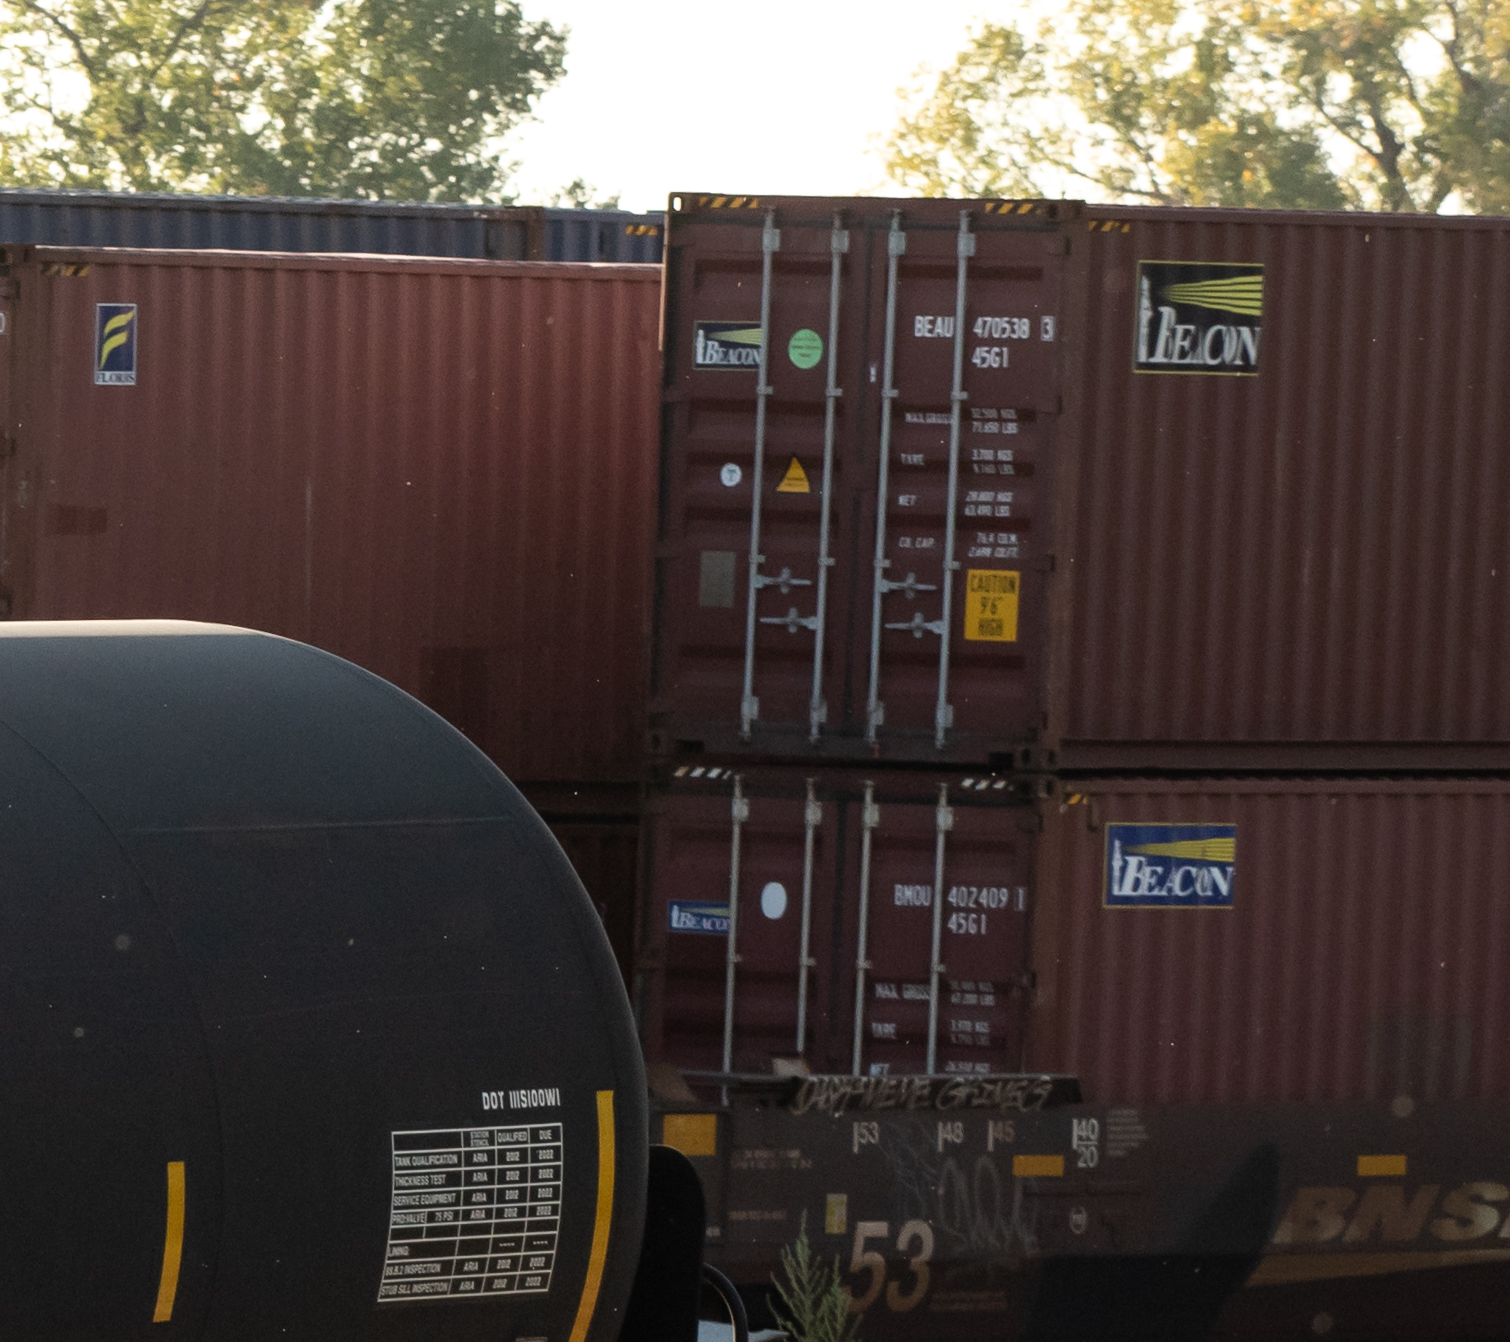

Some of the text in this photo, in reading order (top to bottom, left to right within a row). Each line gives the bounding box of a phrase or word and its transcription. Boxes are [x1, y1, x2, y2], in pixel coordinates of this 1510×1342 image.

[914, 316, 1054, 339] BEAU 470538 3
[971, 346, 1009, 368] 45G1
[1122, 855, 1233, 897] BEACON
[947, 886, 1007, 908] 402409
[946, 913, 988, 935] 45G1
[482, 1092, 504, 1110] DOT
[431, 1174, 446, 1185] TEST
[1272, 1181, 1510, 1243] BNS
[849, 1220, 934, 1313] 53
